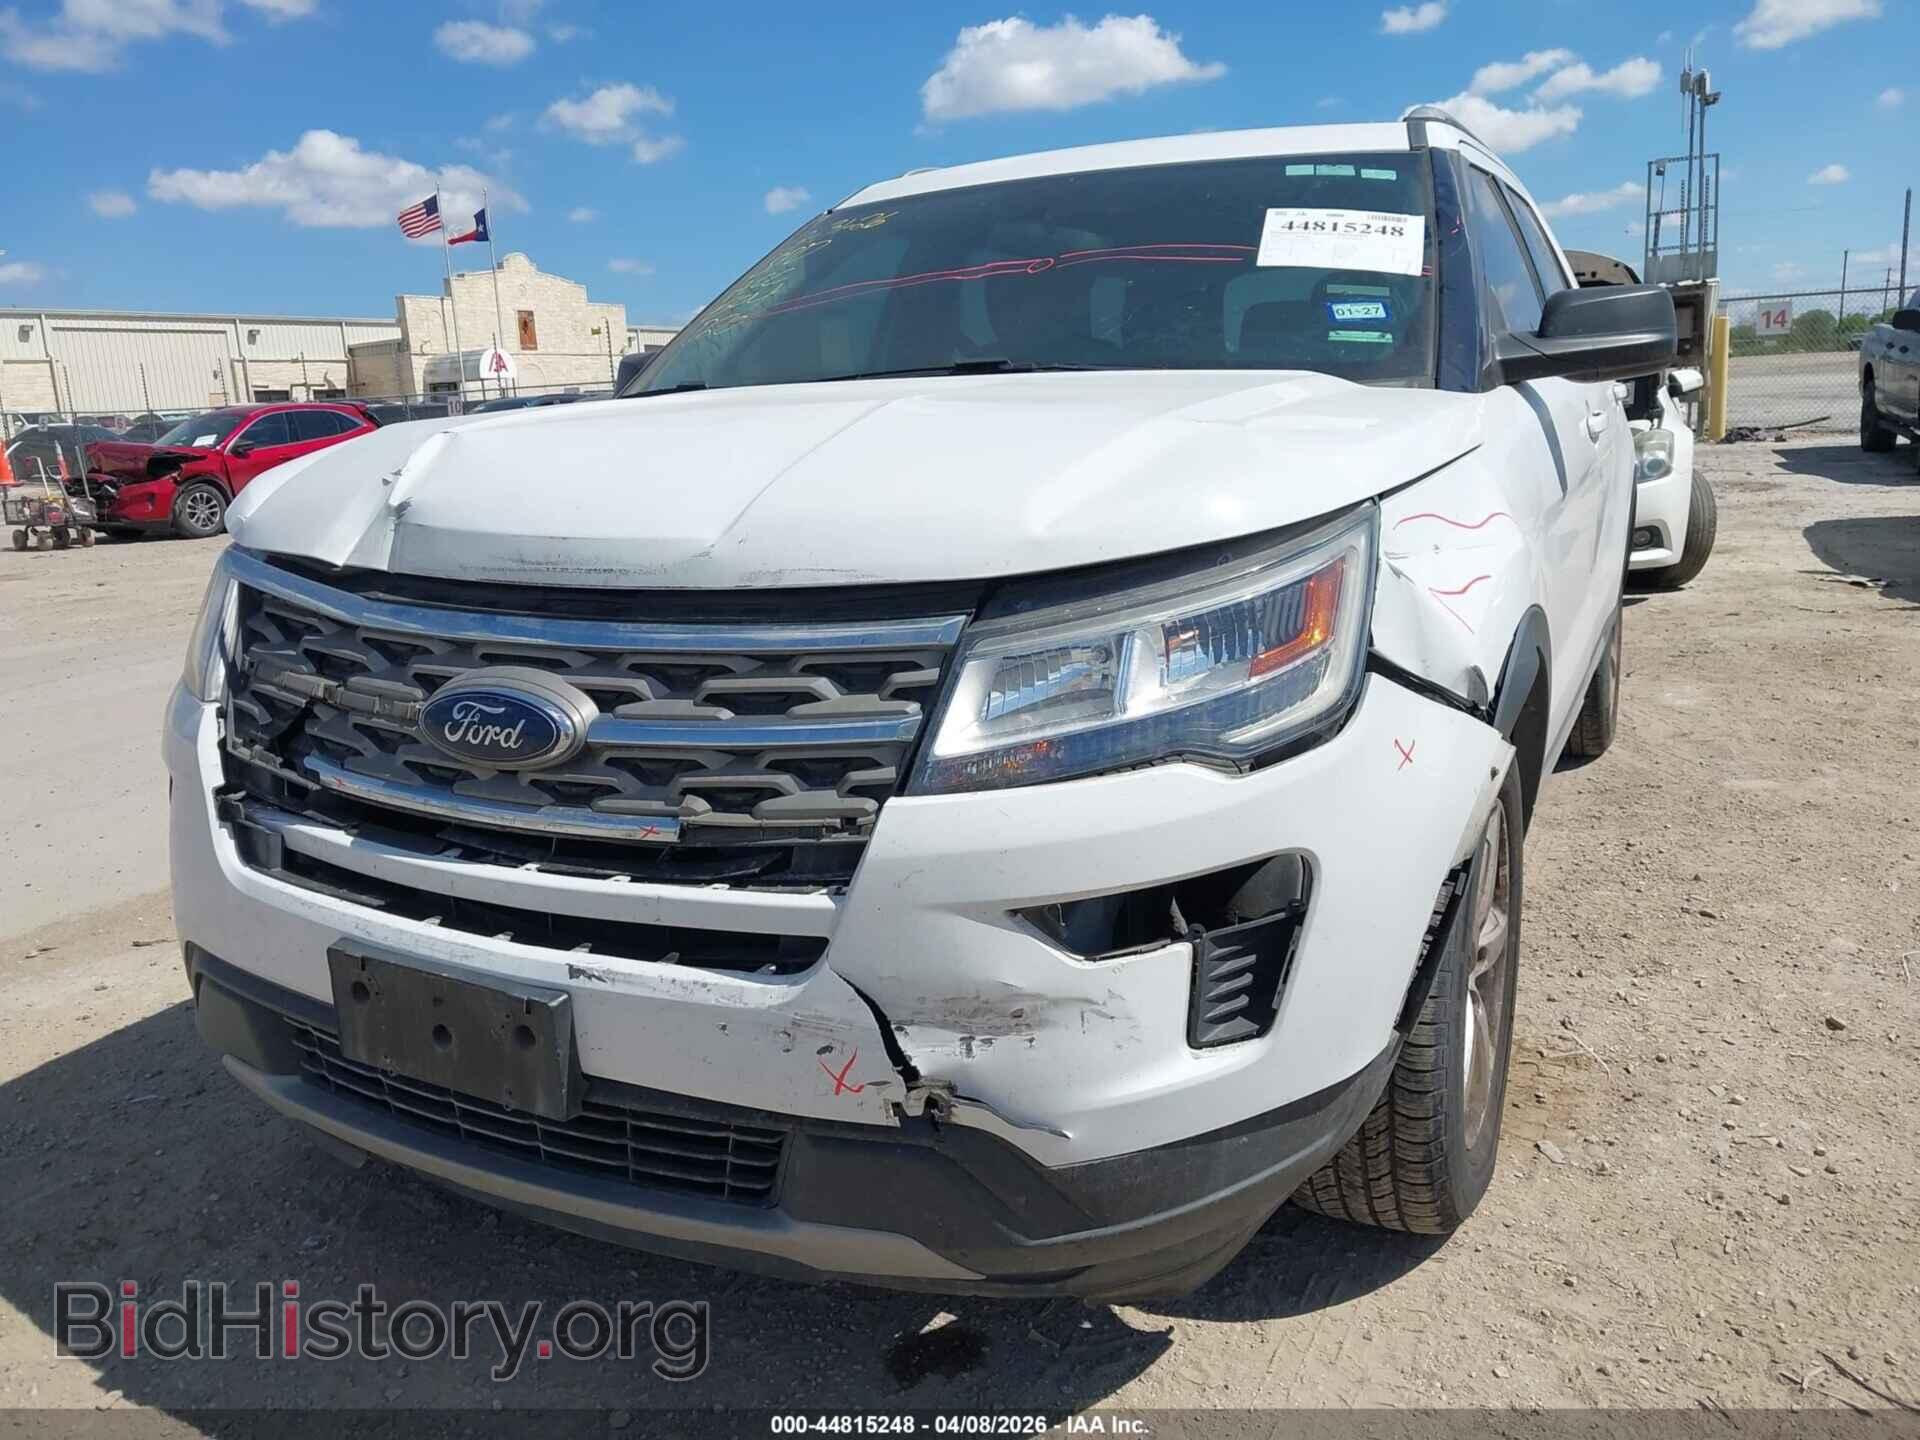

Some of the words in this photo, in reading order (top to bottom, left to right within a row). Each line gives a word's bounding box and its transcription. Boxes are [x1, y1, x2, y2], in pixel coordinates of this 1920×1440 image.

[1281, 220, 1404, 237] 44815248
[1336, 306, 1381, 317] 01-27
[1761, 309, 1788, 329] 14
[444, 701, 524, 749] Ford
